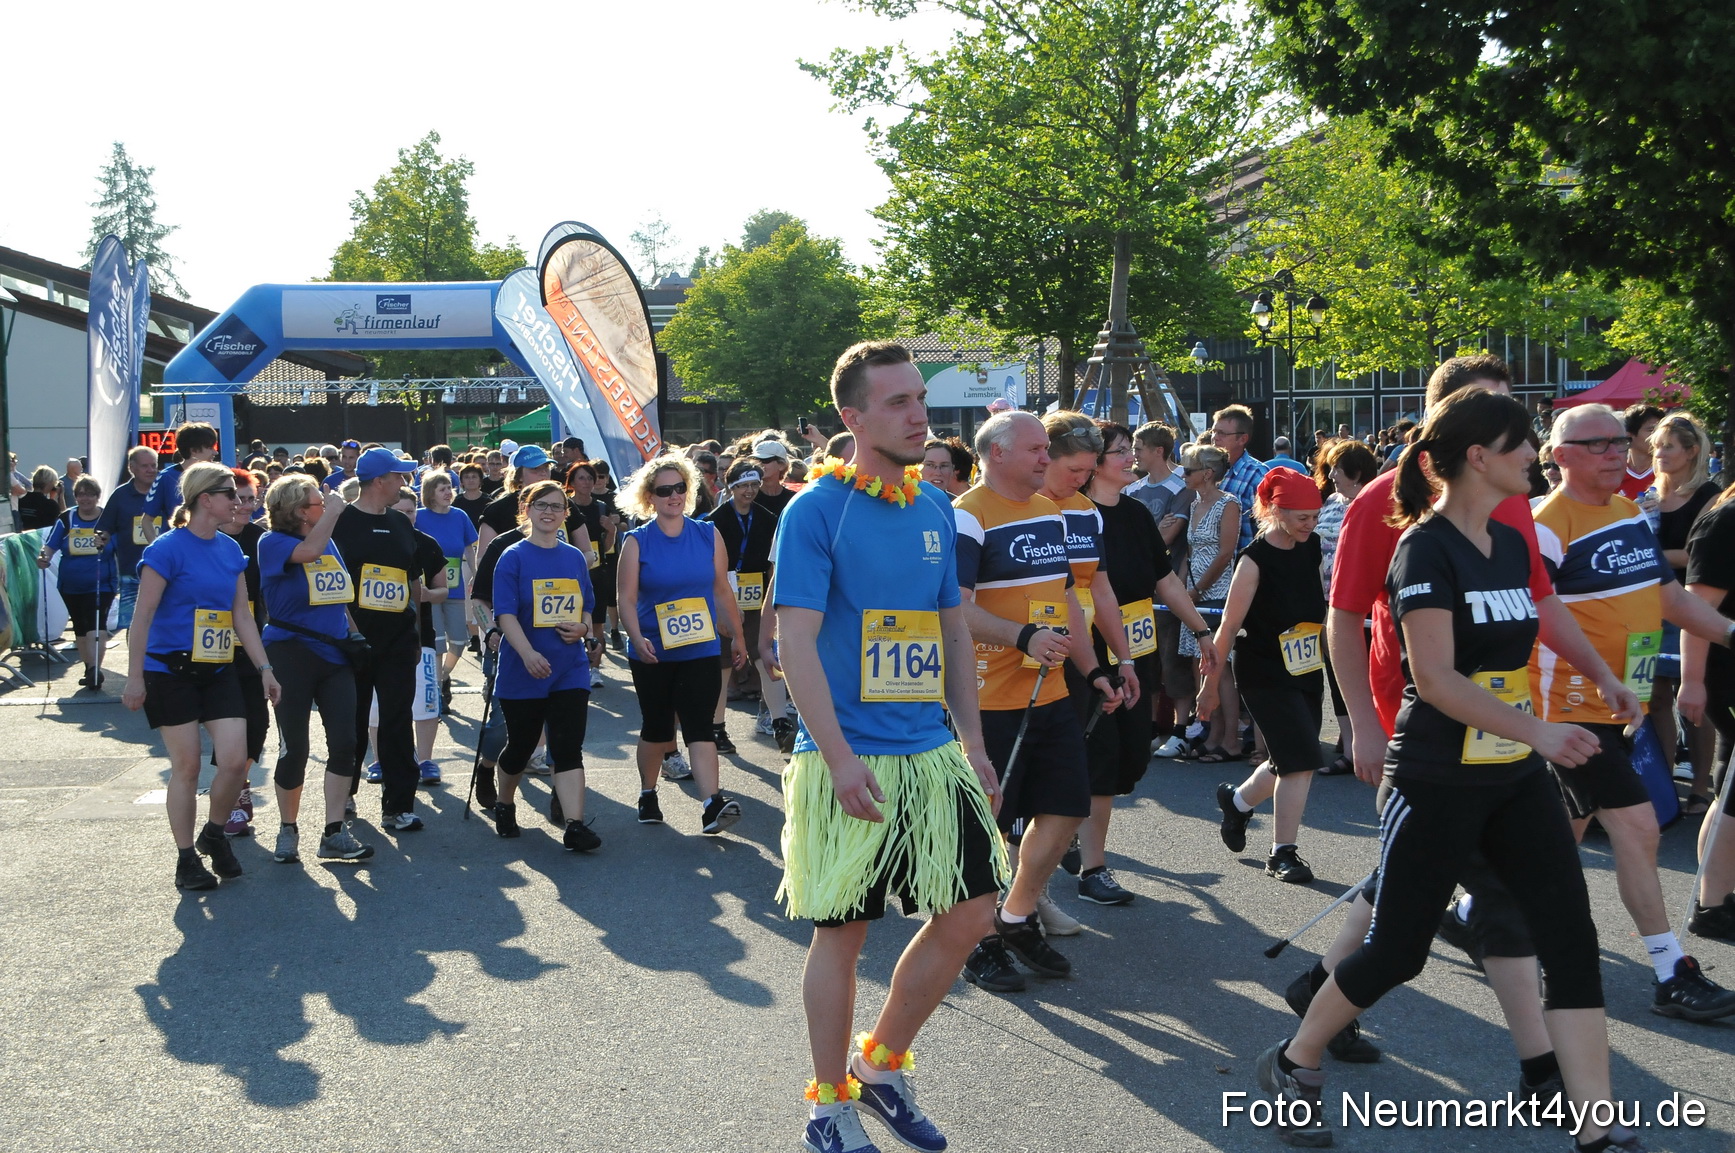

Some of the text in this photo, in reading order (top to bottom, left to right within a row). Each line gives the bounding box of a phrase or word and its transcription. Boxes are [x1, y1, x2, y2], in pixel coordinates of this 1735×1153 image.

[109, 264, 122, 384] Fischer
[365, 315, 441, 329] firmenlauf
[120, 287, 129, 383] AUTOMOBILE
[214, 341, 257, 350] Fischer
[74, 538, 96, 548] 628
[1067, 533, 1093, 544] cher
[1607, 547, 1654, 568] Fischer
[1618, 560, 1658, 575] AUTOMOBILE
[315, 572, 346, 592] 629
[363, 580, 405, 601] 1081
[1398, 582, 1431, 600] THULE
[541, 595, 575, 614] 674
[1464, 587, 1539, 624] THUL
[667, 613, 704, 635] 695
[202, 628, 231, 649] 616
[1284, 635, 1318, 662] 1157
[866, 642, 941, 678] 1164
